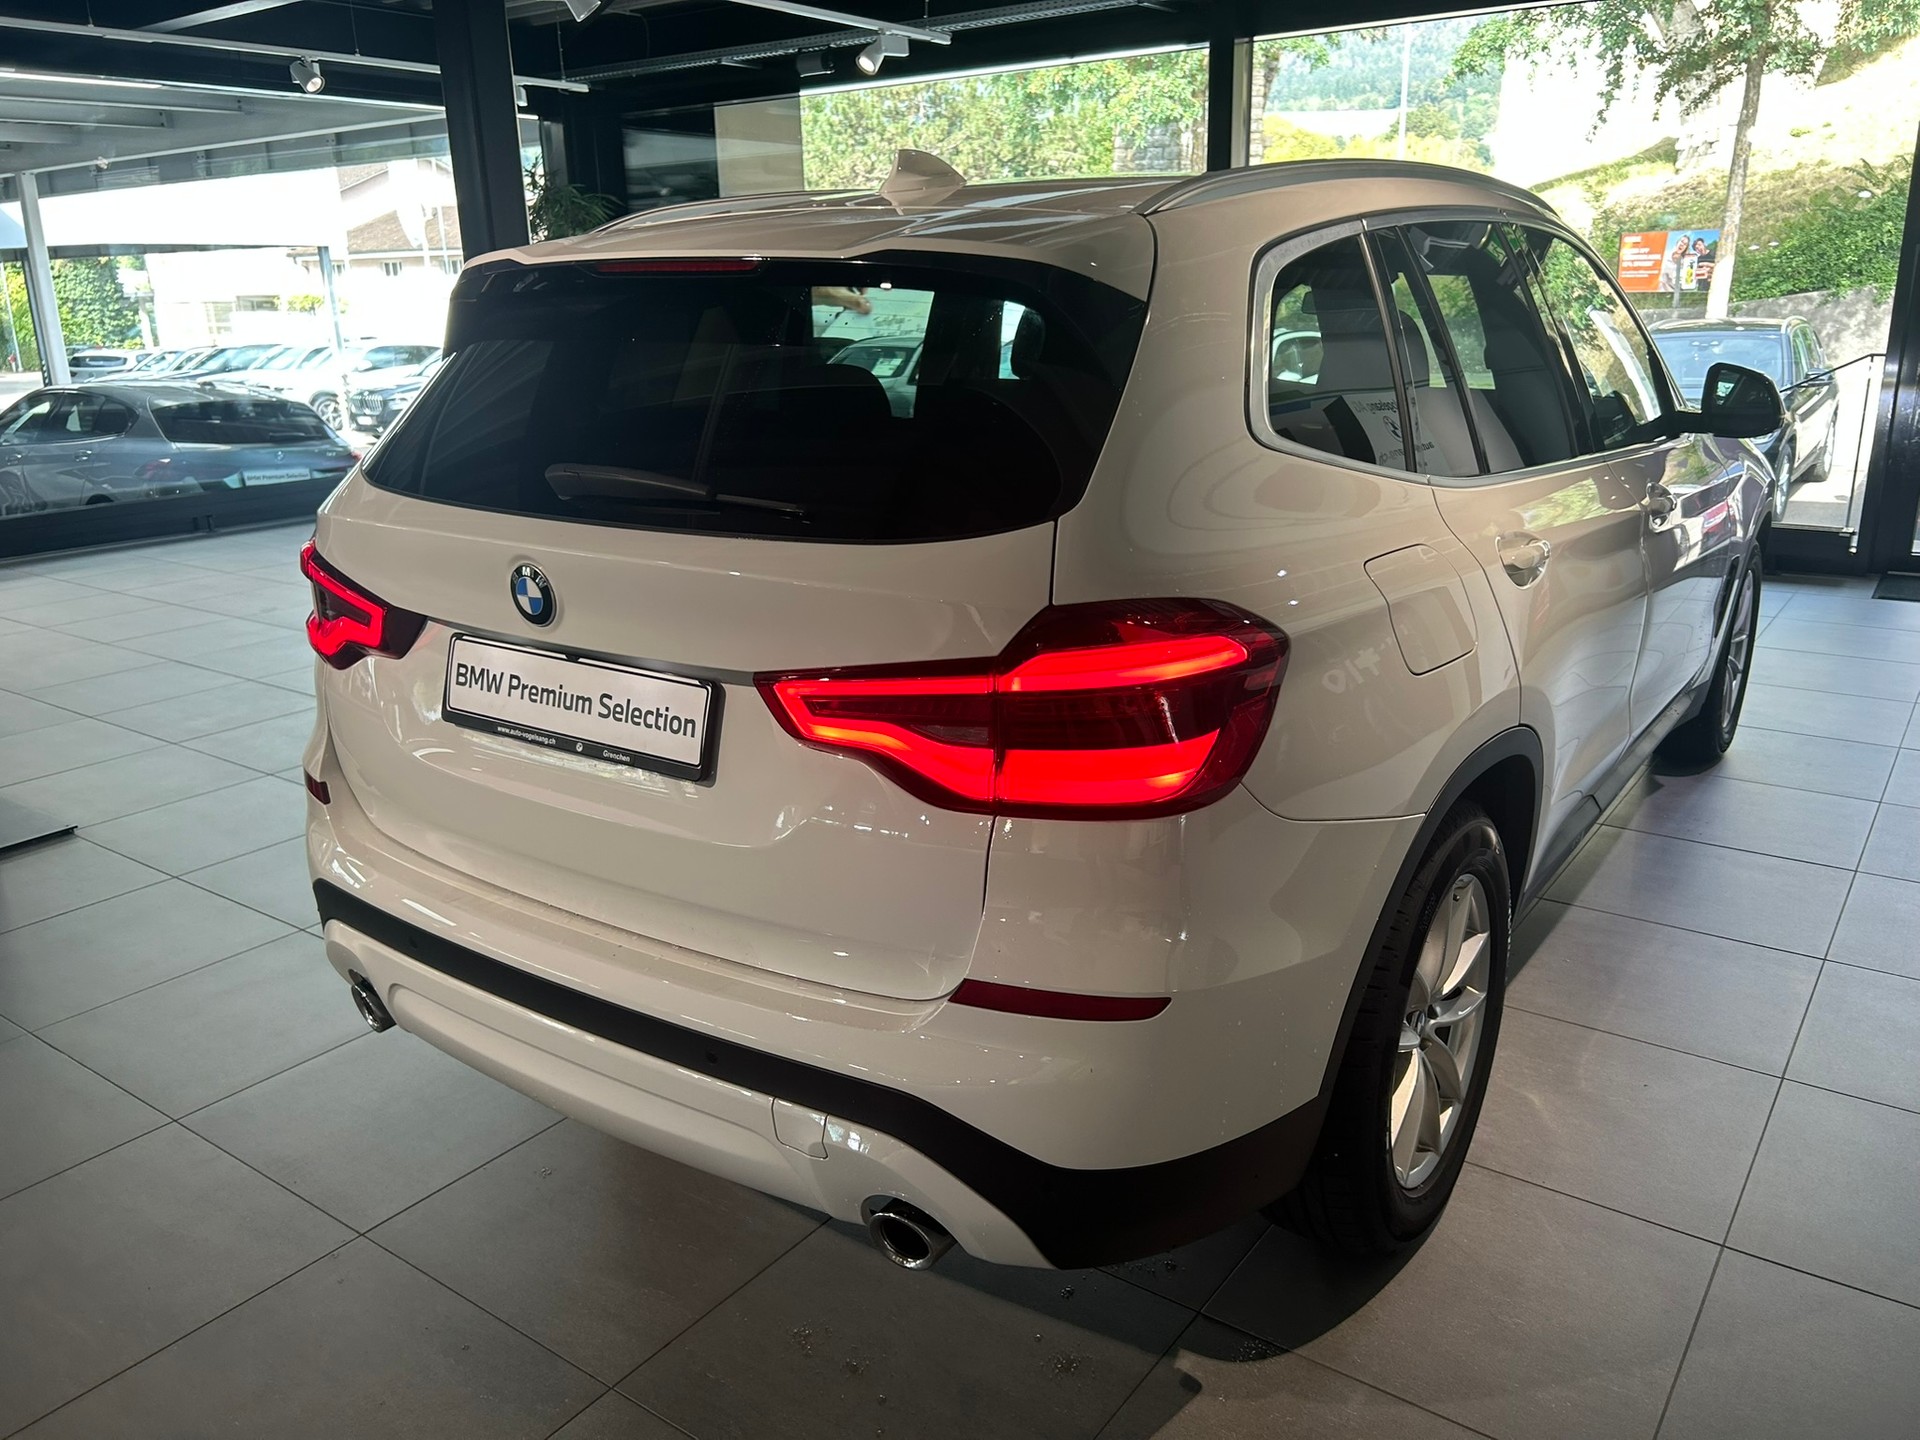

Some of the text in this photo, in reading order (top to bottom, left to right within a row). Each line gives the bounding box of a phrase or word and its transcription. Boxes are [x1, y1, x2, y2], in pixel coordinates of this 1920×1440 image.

[455, 662, 696, 738] BMW Premium Selection
[497, 725, 631, 763] www.auto-vogelsang.ch Grenchen
